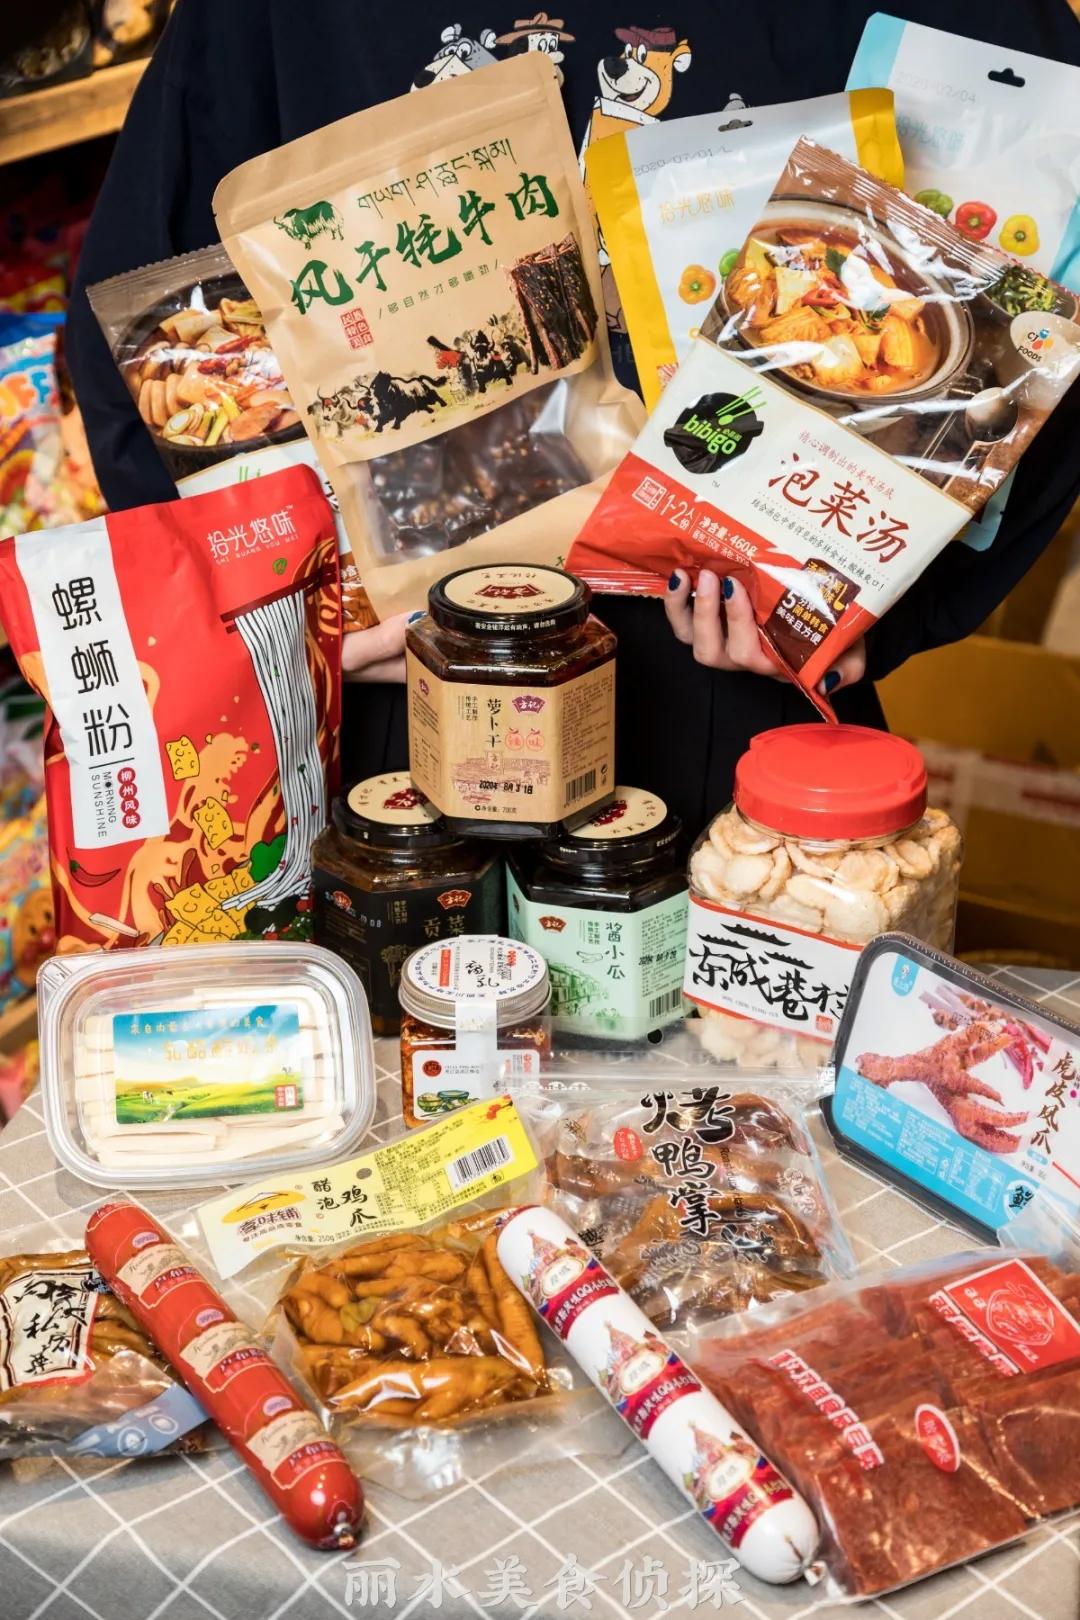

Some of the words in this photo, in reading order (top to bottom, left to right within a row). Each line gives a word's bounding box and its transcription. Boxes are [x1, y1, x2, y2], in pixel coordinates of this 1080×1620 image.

[289, 172, 560, 315] 风干牦牛肉
[1015, 343, 1043, 364] FOODS
[682, 417, 740, 457] bibigo
[206, 513, 297, 560] 拾光悠味
[767, 453, 910, 564] 泡菜汤
[774, 605, 824, 647] 美味且方便
[51, 575, 135, 758] 螺蛳粉
[486, 698, 503, 748] 萝卜干
[90, 773, 108, 839] SUNSHINE
[422, 914, 466, 938] 贡菜
[604, 921, 627, 980] 酱小瓜
[1030, 1051, 1076, 1156] 虎皮凤爪
[640, 1086, 737, 1237] 烤鸭掌
